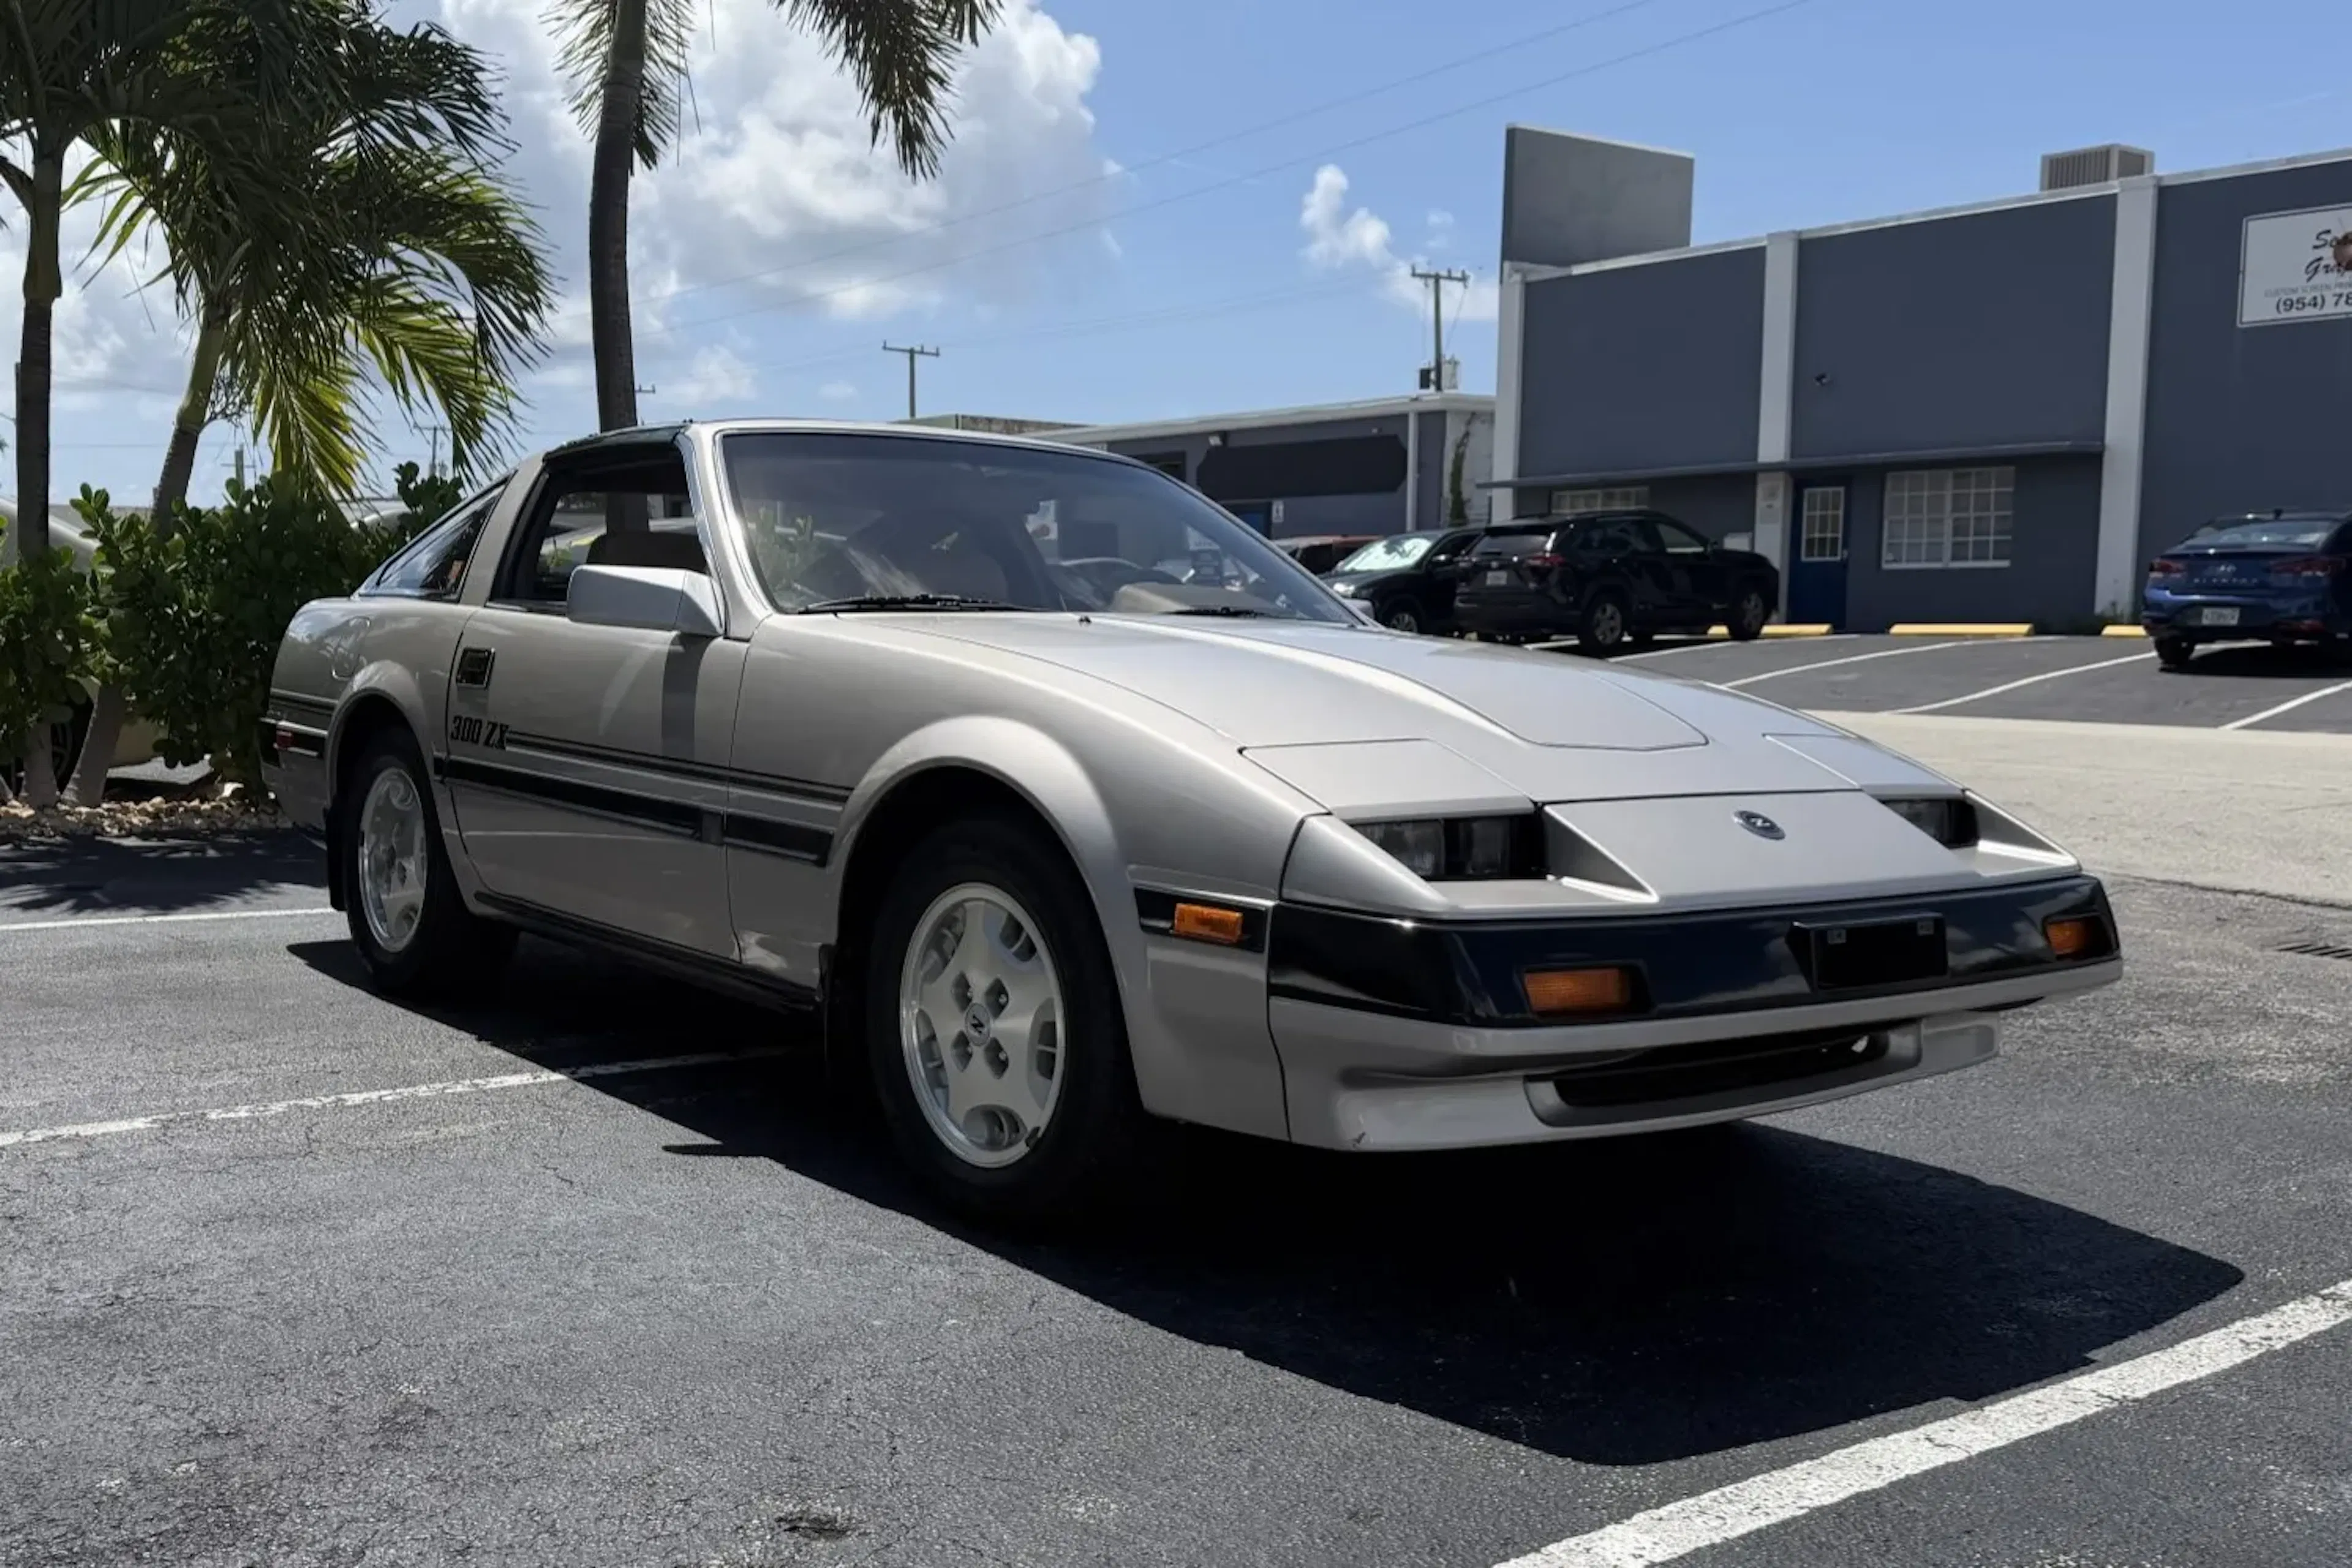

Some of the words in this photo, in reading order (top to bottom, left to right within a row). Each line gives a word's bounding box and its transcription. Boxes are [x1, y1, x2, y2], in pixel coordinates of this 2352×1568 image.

[2276, 295, 2326, 314] (954)
[451, 714, 483, 744] 300
[483, 720, 509, 750] ZX
